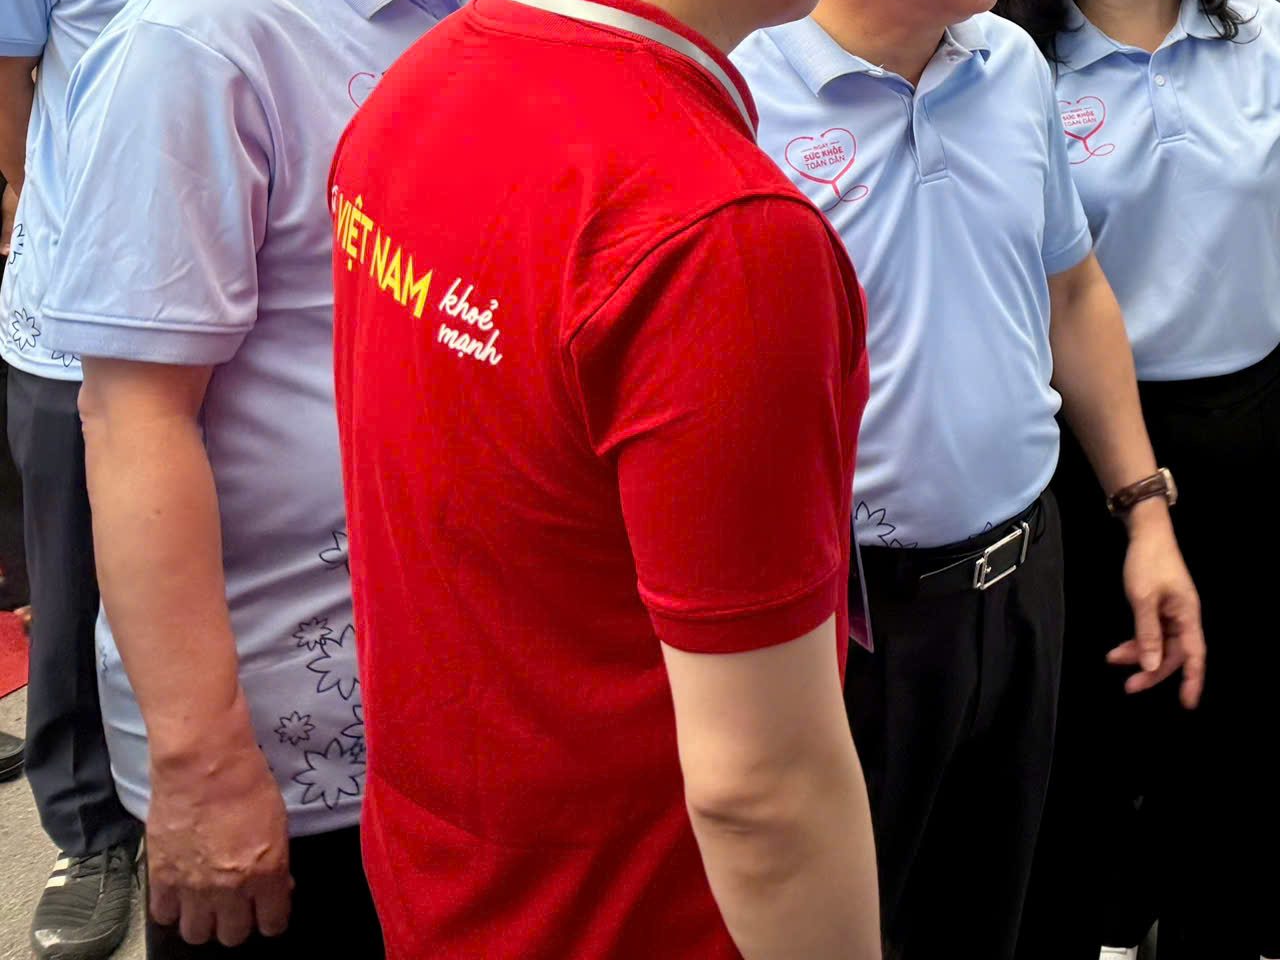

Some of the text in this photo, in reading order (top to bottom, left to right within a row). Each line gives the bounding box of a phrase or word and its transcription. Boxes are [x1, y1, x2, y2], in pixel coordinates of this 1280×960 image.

[336, 193, 433, 319] VIỆT NAM
[437, 323, 503, 366] mạnh
